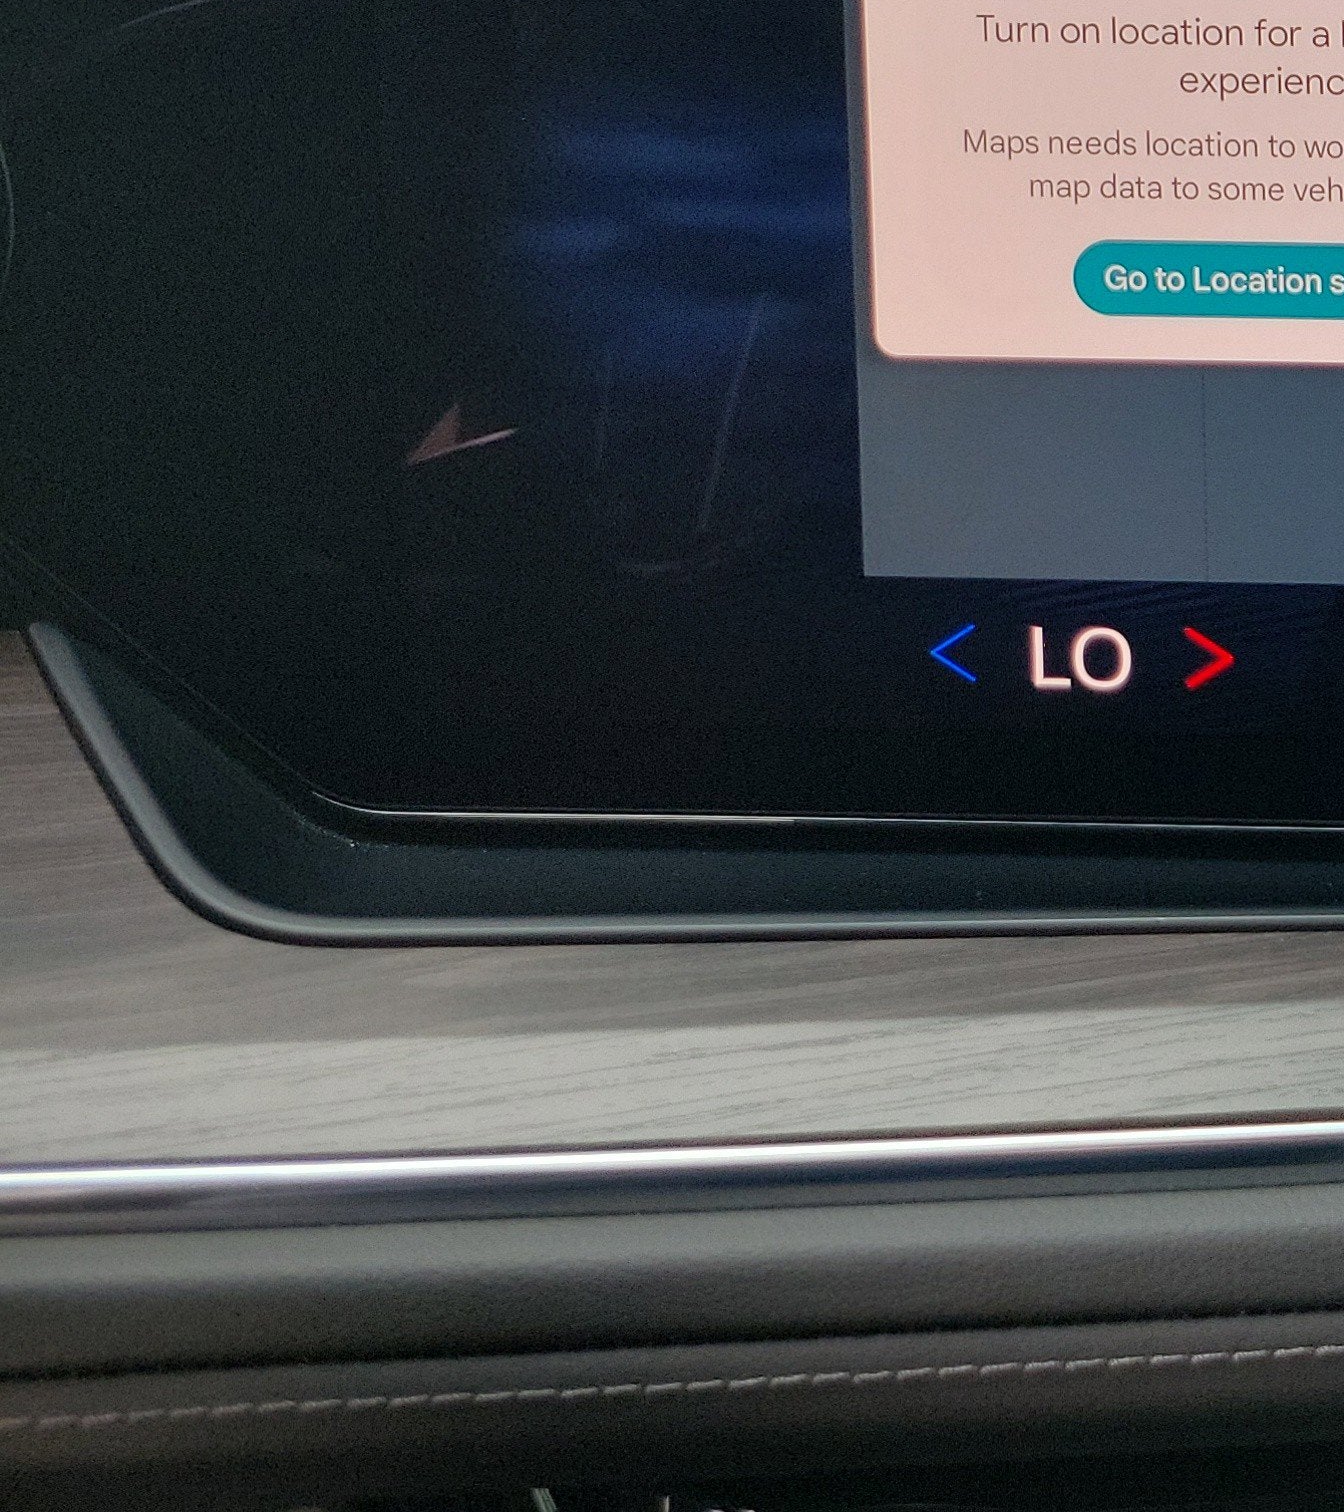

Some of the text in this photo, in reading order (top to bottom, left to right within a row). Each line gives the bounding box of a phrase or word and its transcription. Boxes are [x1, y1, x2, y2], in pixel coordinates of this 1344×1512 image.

[977, 15, 1051, 46] Turn
[1060, 22, 1103, 46] on
[1110, 17, 1245, 50] location
[1254, 17, 1302, 50] for
[1311, 25, 1331, 50] a
[963, 129, 1040, 159] Maps
[1048, 131, 1137, 158] needs
[1145, 130, 1259, 159] location
[1268, 133, 1297, 159] to
[1029, 175, 1091, 206] map
[1099, 171, 1163, 202] data
[1172, 176, 1200, 202] to
[1207, 180, 1285, 204] some
[1104, 265, 1148, 294] Go
[1155, 268, 1186, 294] to
[1193, 266, 1323, 297] Location
[1029, 624, 1132, 693] LO
